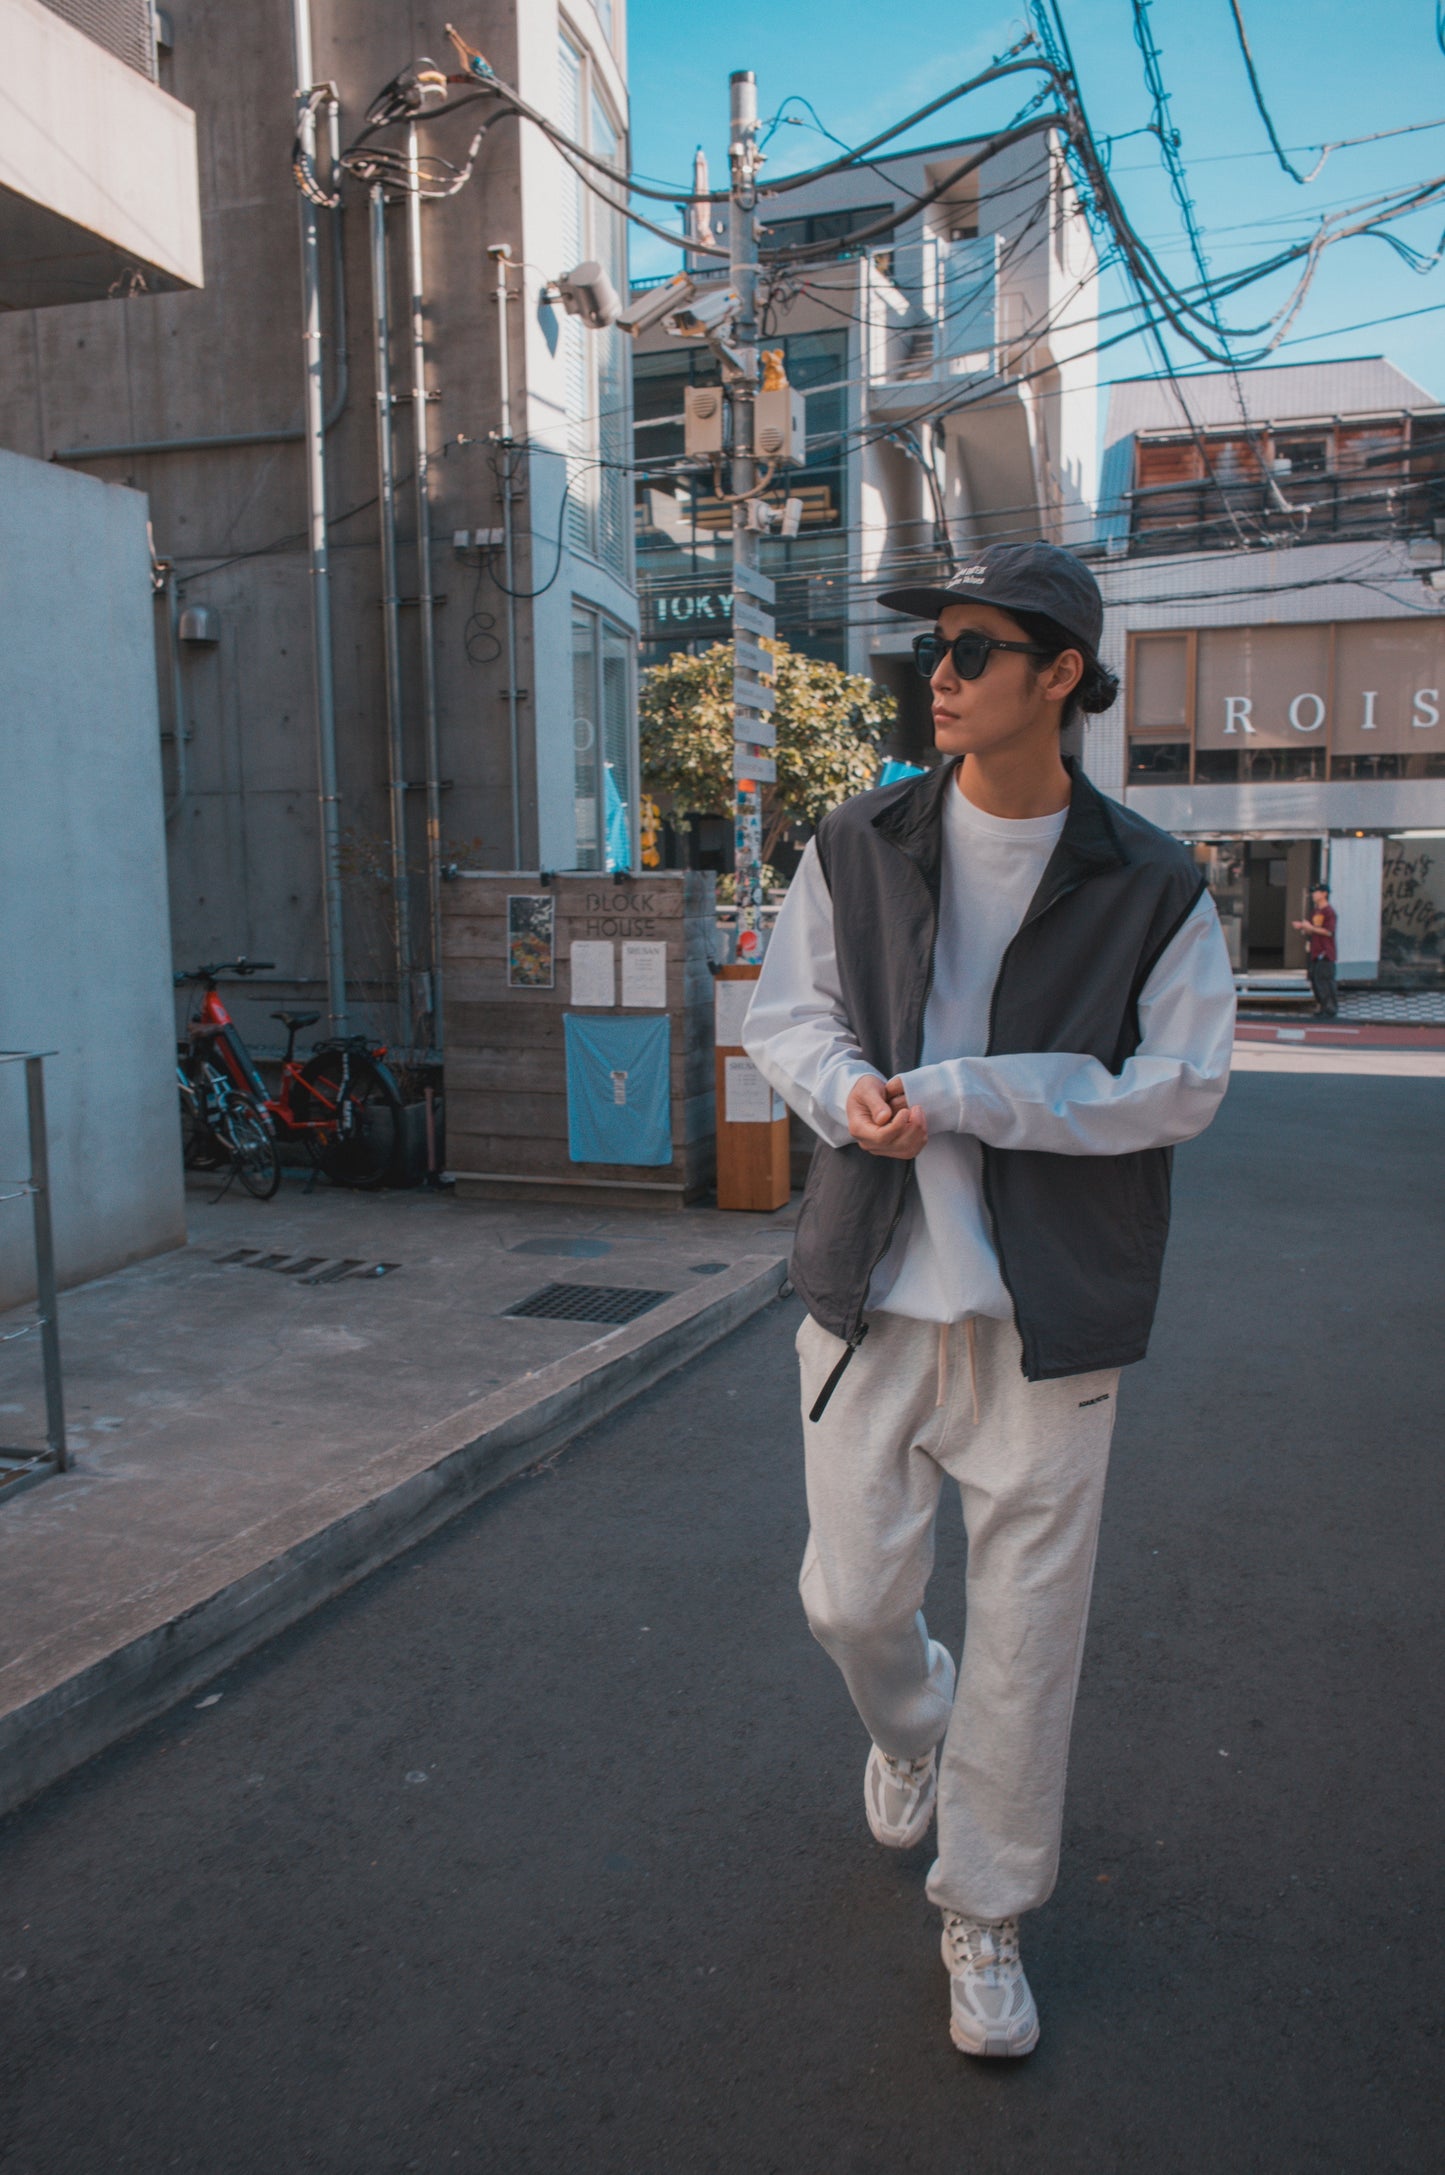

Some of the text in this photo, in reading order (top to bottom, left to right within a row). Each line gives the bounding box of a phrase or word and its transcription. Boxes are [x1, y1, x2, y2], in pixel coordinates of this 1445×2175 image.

[1223, 688, 1440, 733] ROIS
[585, 893, 654, 912] BLOCK
[586, 918, 656, 937] HOUSE
